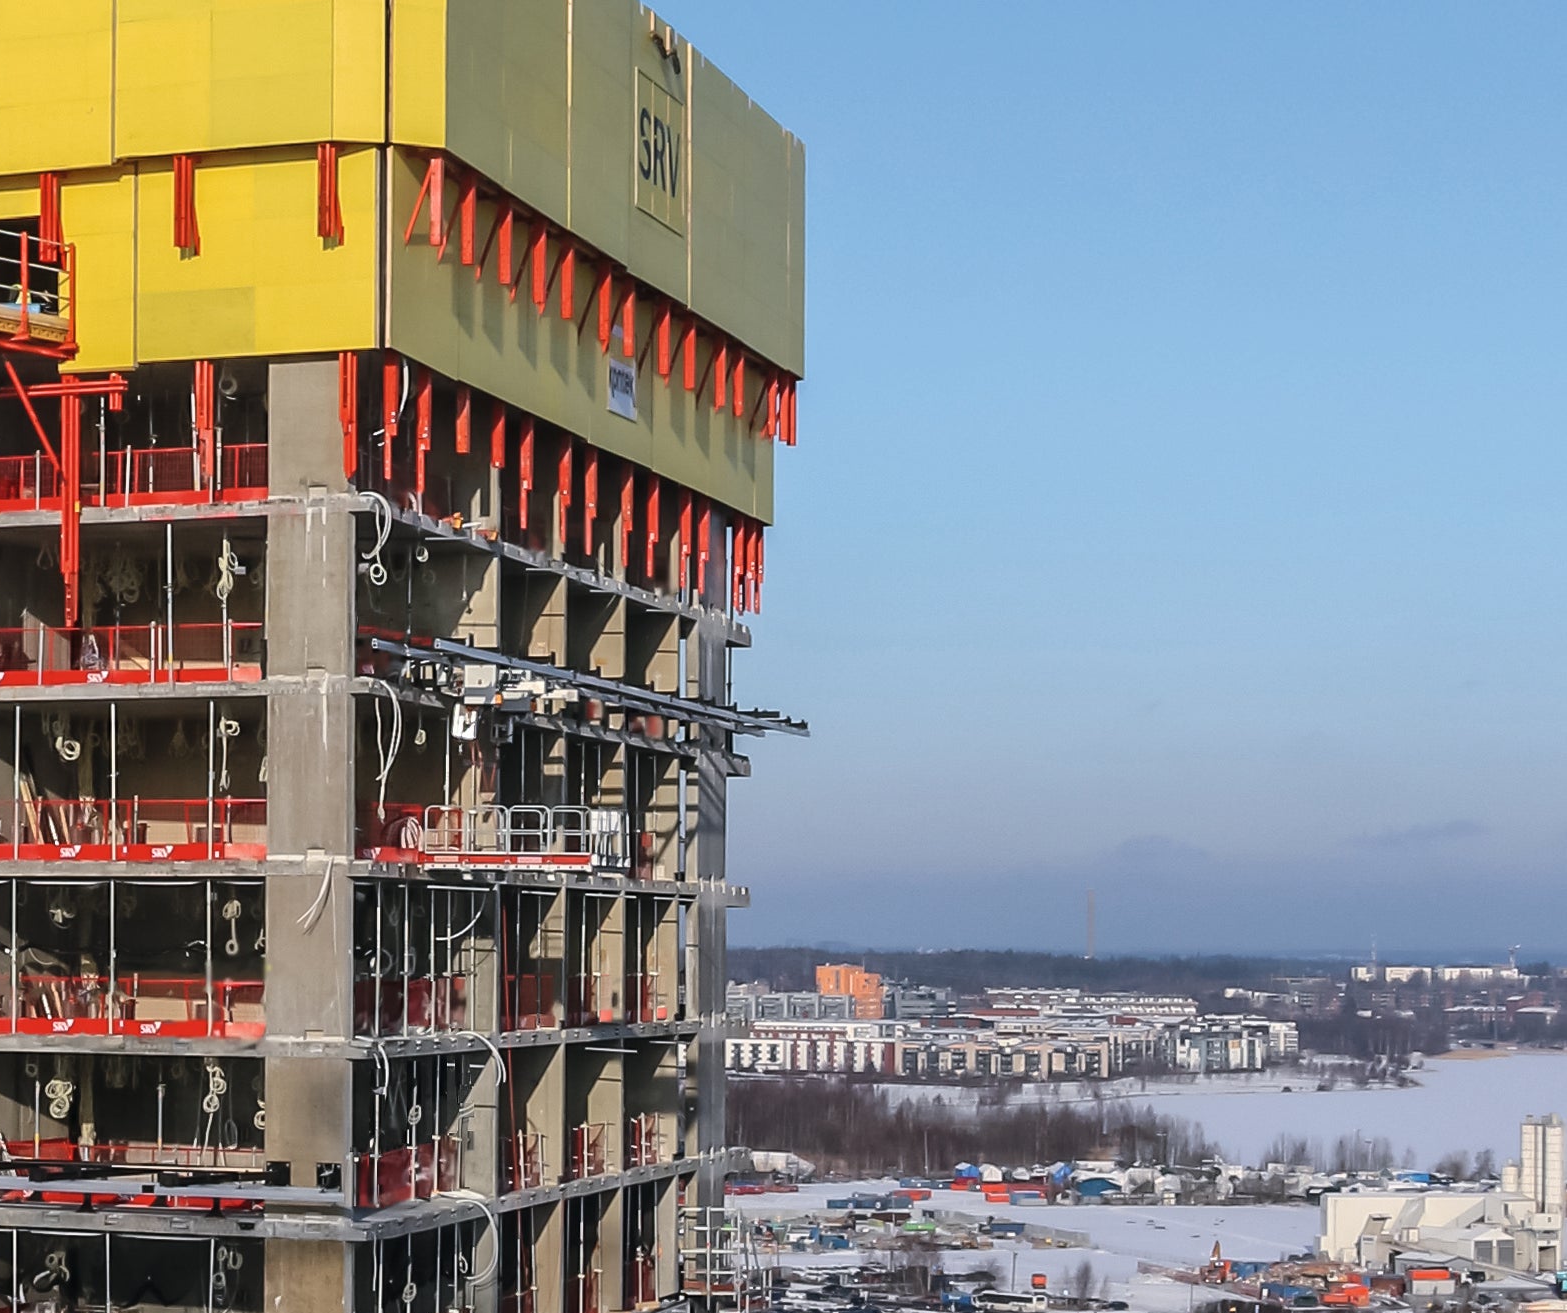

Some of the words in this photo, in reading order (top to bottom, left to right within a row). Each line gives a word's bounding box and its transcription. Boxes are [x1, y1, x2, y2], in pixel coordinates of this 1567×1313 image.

[639, 108, 680, 198] SRV
[88, 671, 108, 683] SRV
[60, 845, 81, 858] SRV
[152, 846, 173, 858] SRV
[53, 1019, 73, 1031] SRV
[141, 1022, 161, 1033] SRV
